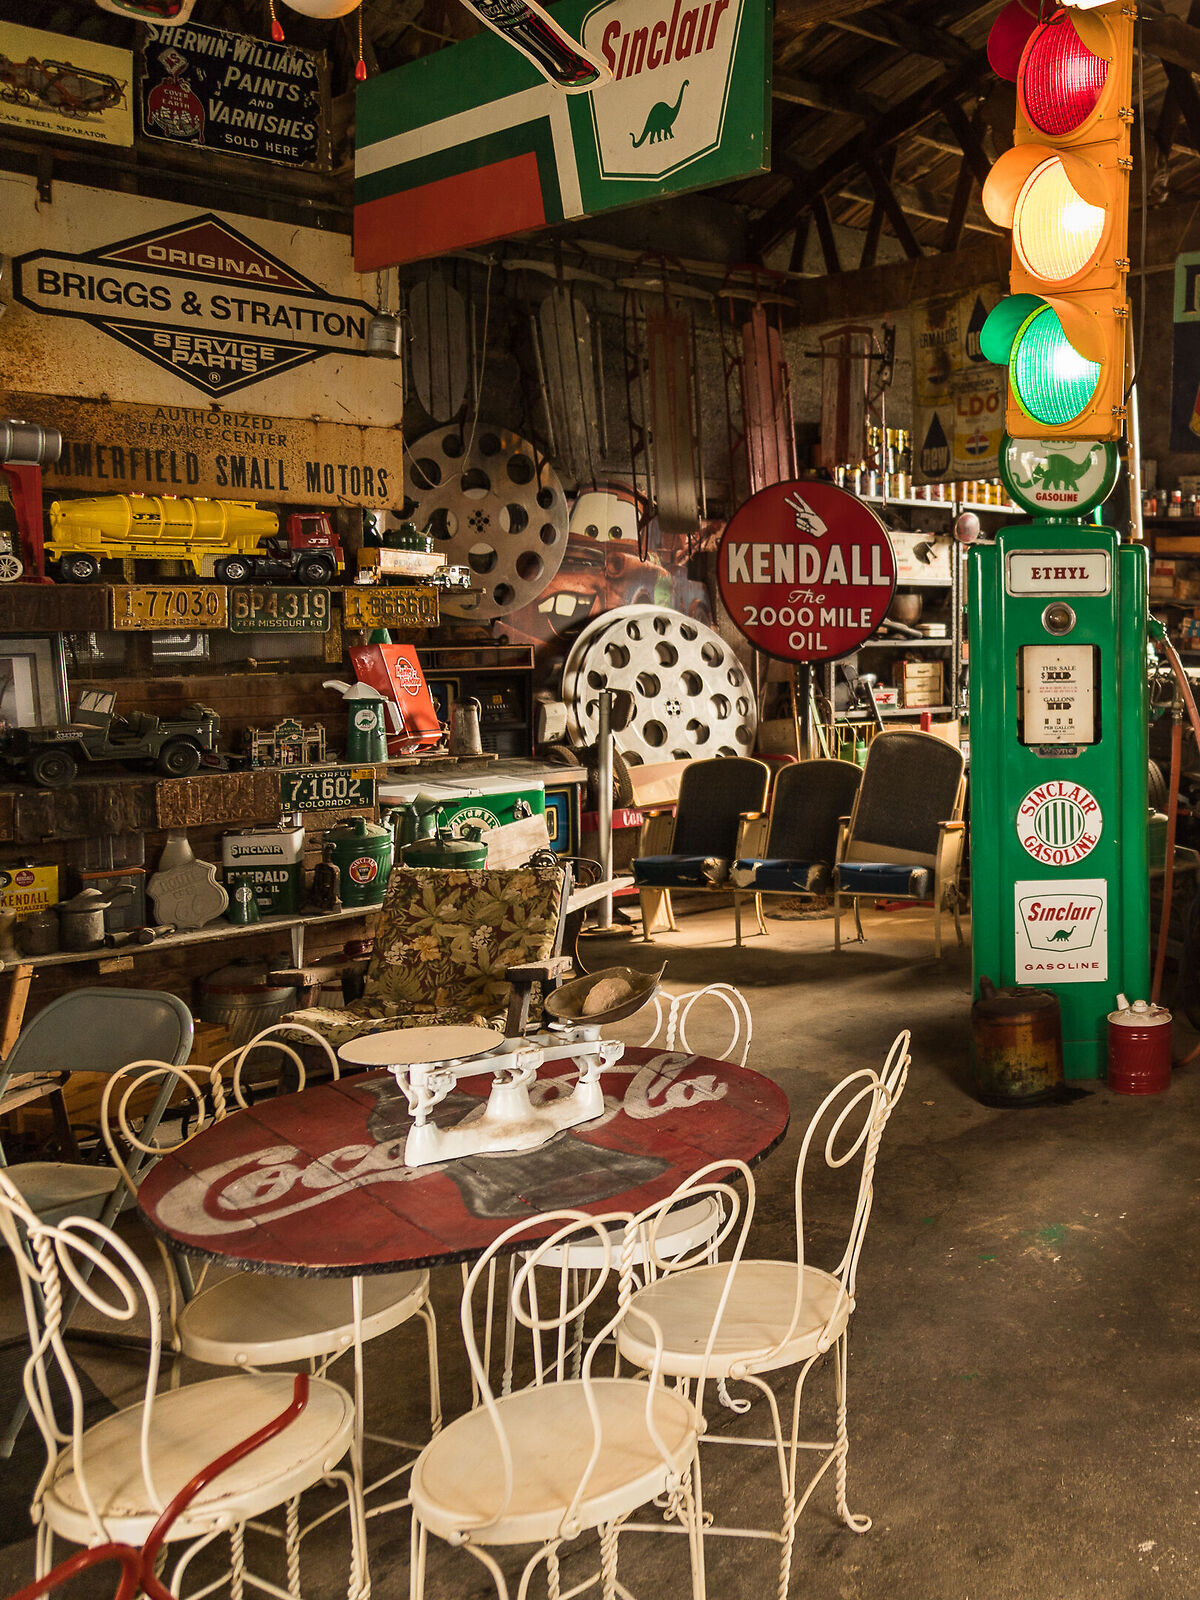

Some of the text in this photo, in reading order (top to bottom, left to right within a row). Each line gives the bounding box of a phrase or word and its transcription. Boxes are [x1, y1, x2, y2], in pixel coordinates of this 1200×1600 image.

[146, 22, 316, 79] SHERWIN-WILLIAMS
[601, 0, 730, 82] Sinclair
[163, 88, 189, 98] COVER
[224, 66, 301, 102] PAINTS
[162, 98, 190, 109] EARTH
[249, 98, 274, 110] AND
[25, 118, 53, 129] STEEL
[56, 124, 108, 140] SEPARATOR
[209, 98, 316, 141] VARNISHES
[225, 134, 299, 157] SOLD HERE
[146, 245, 279, 281] ORIGINAL
[37, 268, 366, 340] BRIGGS & STRATTON
[153, 334, 275, 361] SERVICE
[172, 349, 258, 373] PARTS
[154, 407, 273, 430] AUTHORIZED
[138, 422, 288, 448] SERVICE CENTER
[43, 441, 389, 498] MMERFIELD SMALL MOTORS
[1035, 492, 1079, 502] GASOLINE
[728, 543, 891, 587] KENDALL
[1031, 567, 1089, 580] ETHYL
[787, 589, 827, 605] The
[259, 619, 305, 627] MISSOURI
[743, 606, 872, 628] 2000 MILE
[788, 631, 828, 652] OIL
[301, 771, 351, 779] COLORFUL
[298, 799, 351, 809] COLORADO
[1021, 782, 1098, 817] SINCLAIR
[453, 810, 496, 829] INCLAIR
[231, 845, 283, 858] SINCLAIR
[1023, 831, 1098, 864] GASOLINE
[1, 891, 49, 907] KENDALL
[16, 903, 49, 912] CIALIZED
[1027, 902, 1096, 922] Sinclair
[1024, 962, 1099, 971] GASOLINE
